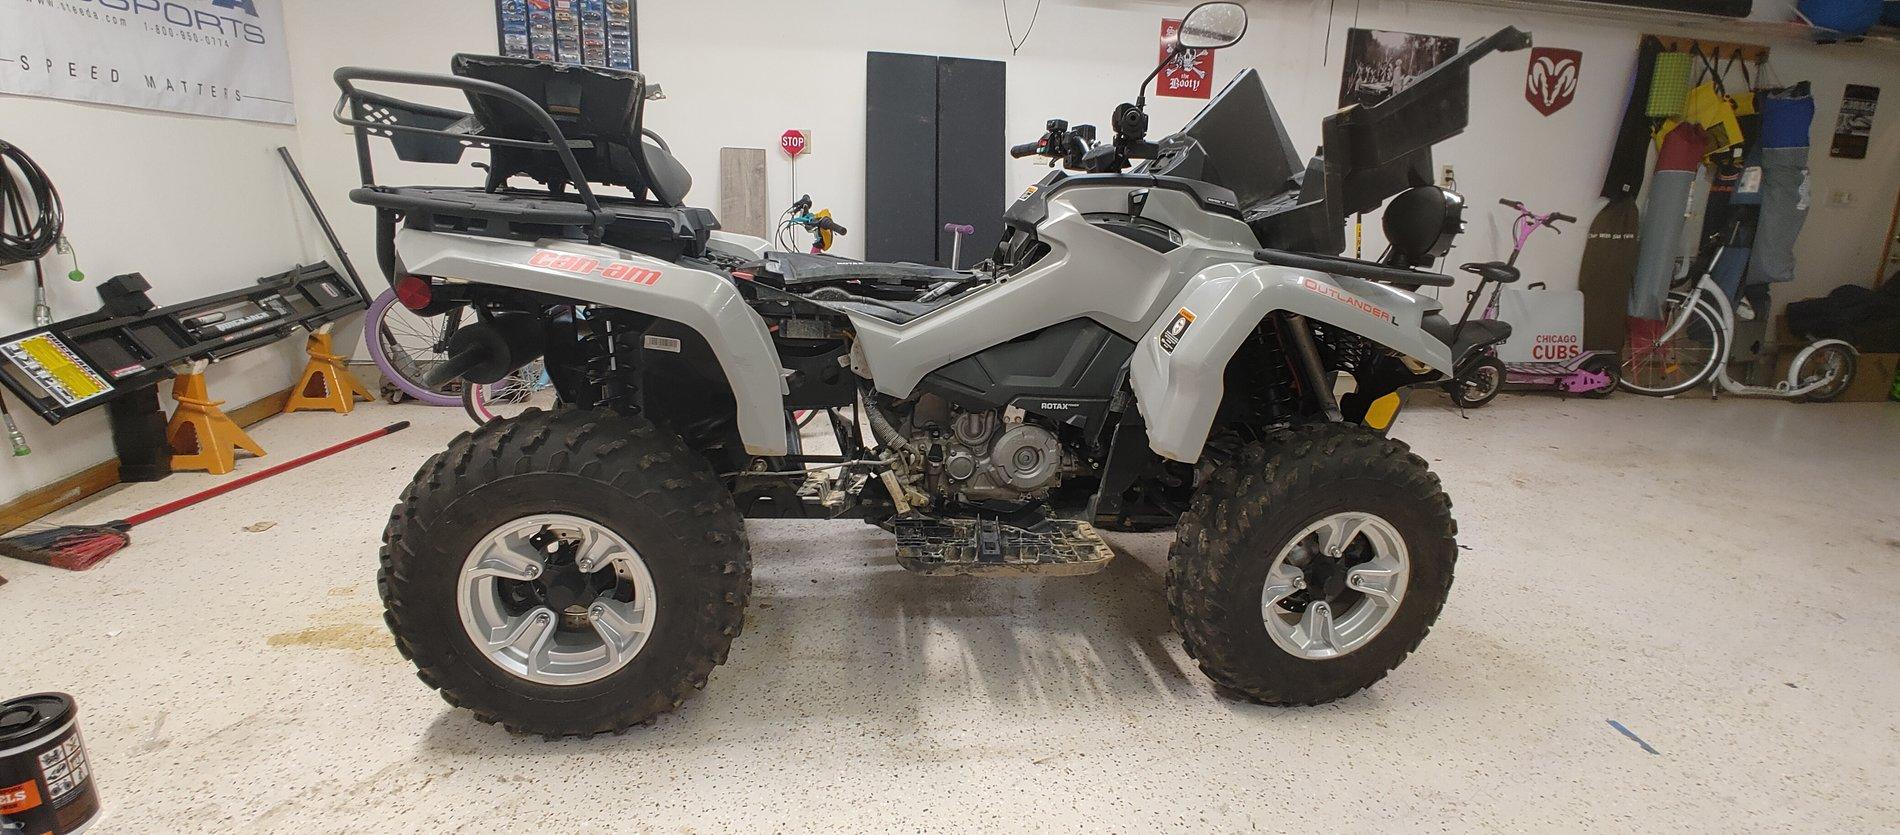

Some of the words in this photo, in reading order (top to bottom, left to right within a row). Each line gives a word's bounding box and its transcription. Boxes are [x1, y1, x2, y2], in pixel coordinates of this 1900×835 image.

[20, 54, 120, 83] SPEED
[144, 74, 242, 102] MATTERS
[1169, 78, 1200, 92] Booty
[782, 136, 804, 147] STOP
[528, 249, 663, 287] can-am
[1304, 278, 1390, 322] OUTLANDER
[1391, 315, 1399, 327] L
[1536, 334, 1577, 344] CHICAGO
[1532, 344, 1579, 360] CUBS
[1041, 402, 1068, 410] ROTAX
